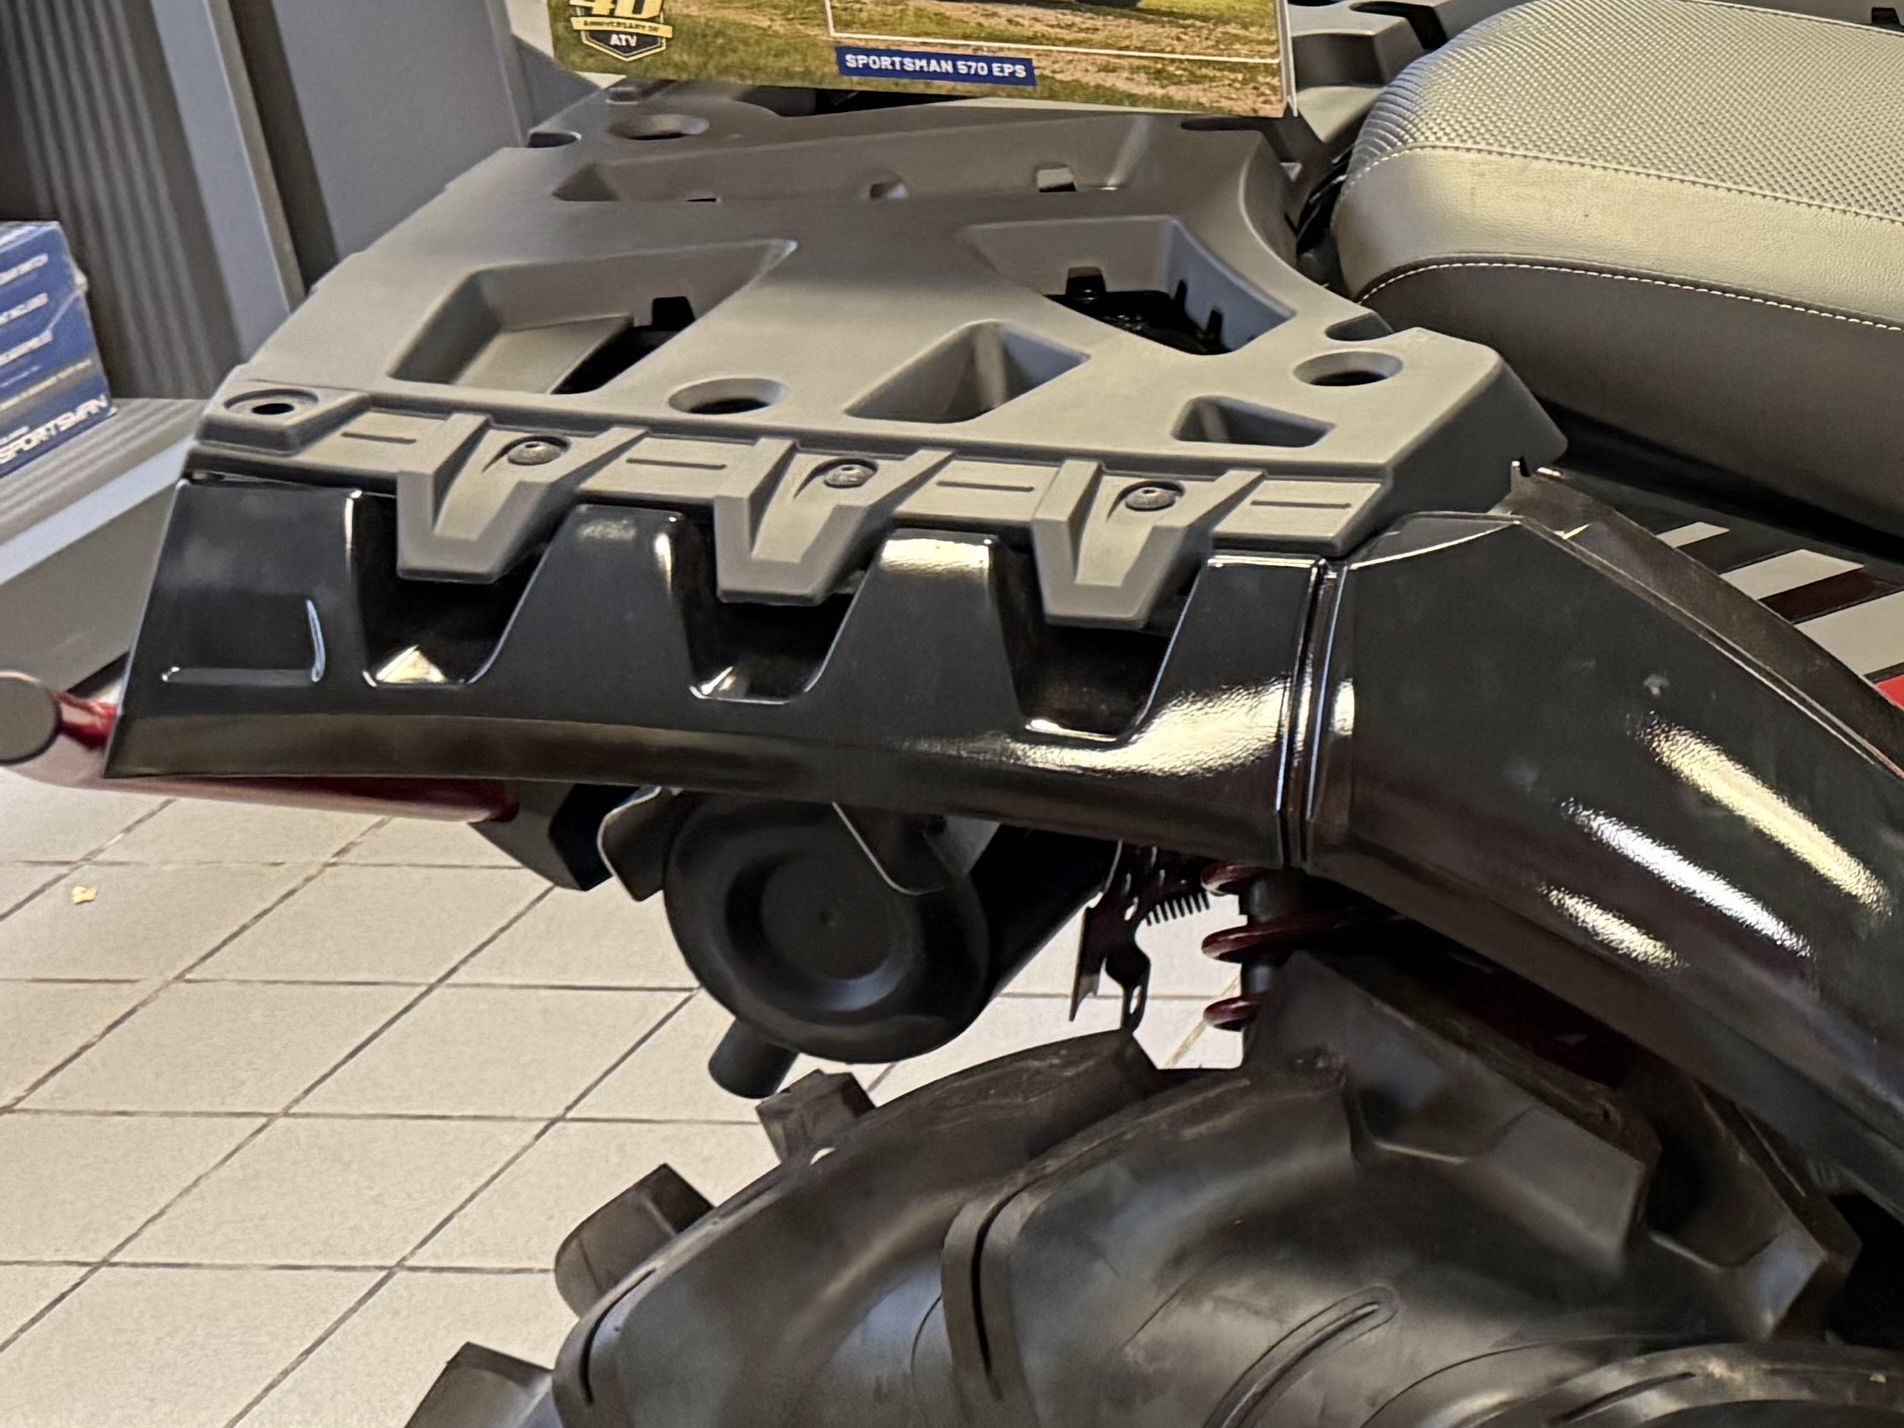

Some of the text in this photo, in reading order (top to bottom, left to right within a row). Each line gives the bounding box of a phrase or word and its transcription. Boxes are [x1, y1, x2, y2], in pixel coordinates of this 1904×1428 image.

[609, 33, 638, 47] ATV
[844, 53, 1027, 79] SPORTSMAN 570 EPS
